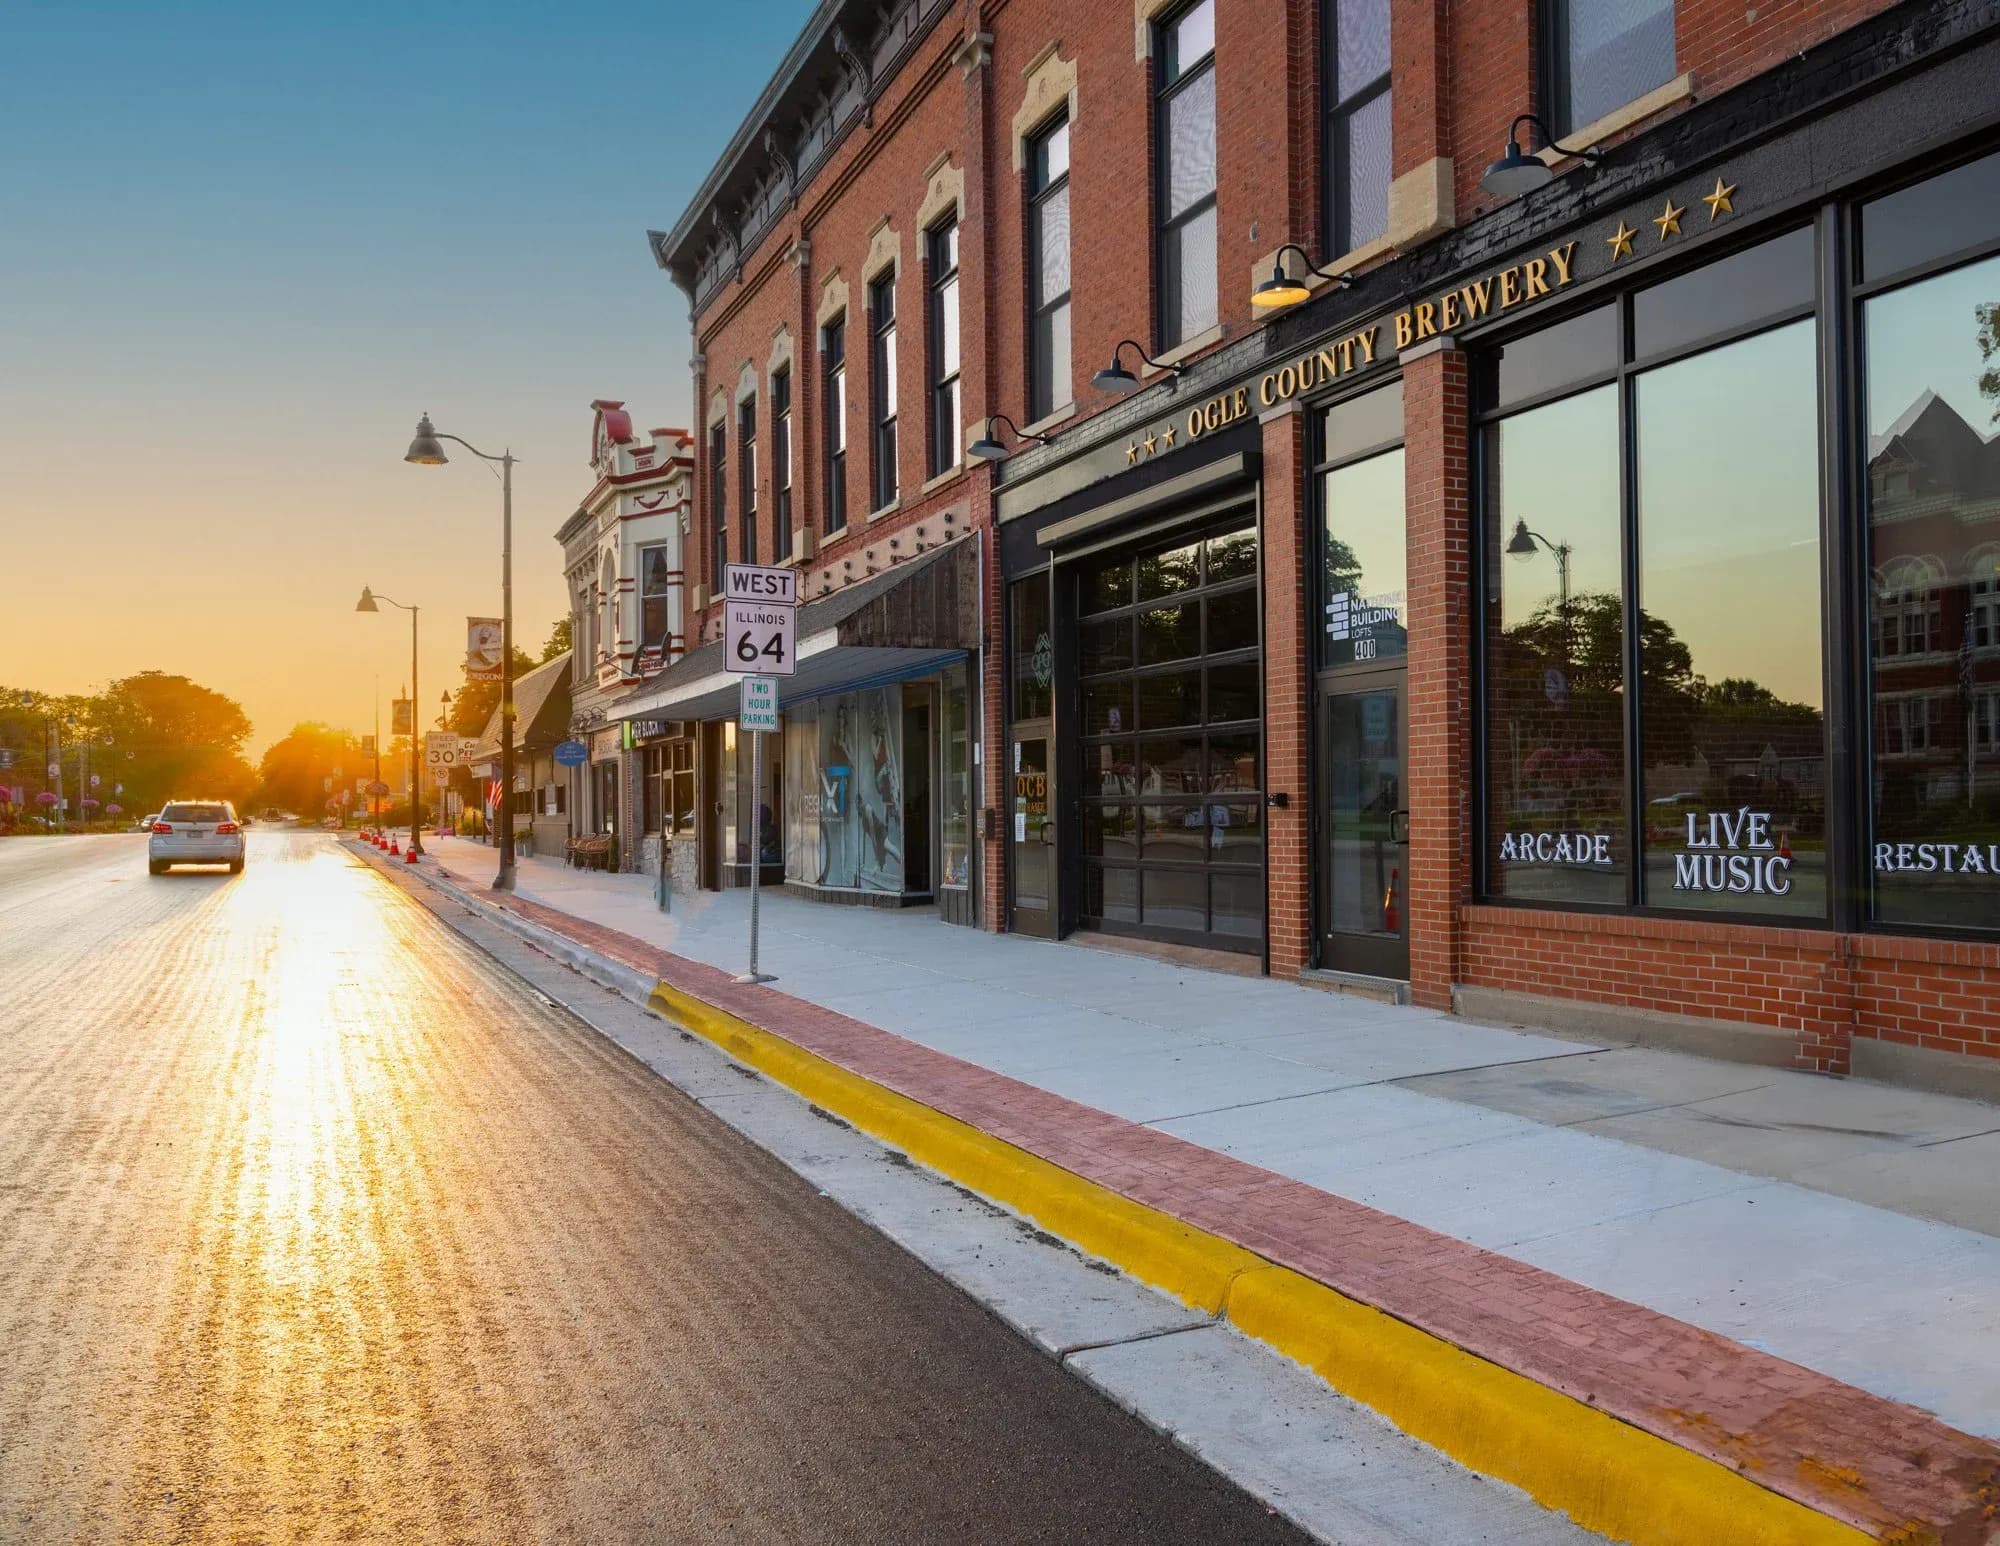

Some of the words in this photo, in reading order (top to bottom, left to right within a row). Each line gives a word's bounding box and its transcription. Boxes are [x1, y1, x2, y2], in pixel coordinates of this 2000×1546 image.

[1187, 385, 1249, 437] OGLE
[1260, 326, 1379, 407] COUNTY
[1394, 240, 1579, 350] BREWERY
[732, 572, 790, 595] WEST
[736, 611, 786, 625] ILLINOIS
[1351, 626, 1372, 639] LOFTS
[736, 629, 785, 664] 64
[1355, 639, 1375, 659] 400
[751, 682, 769, 694] TWO
[748, 698, 771, 709] HOUR
[743, 713, 775, 725] PARKING
[429, 750, 455, 763] 30
[1017, 775, 1045, 798] OCB
[1687, 804, 1775, 850] LIVE
[1500, 832, 1613, 864] ARCADE
[1674, 855, 1791, 894] MUSIC
